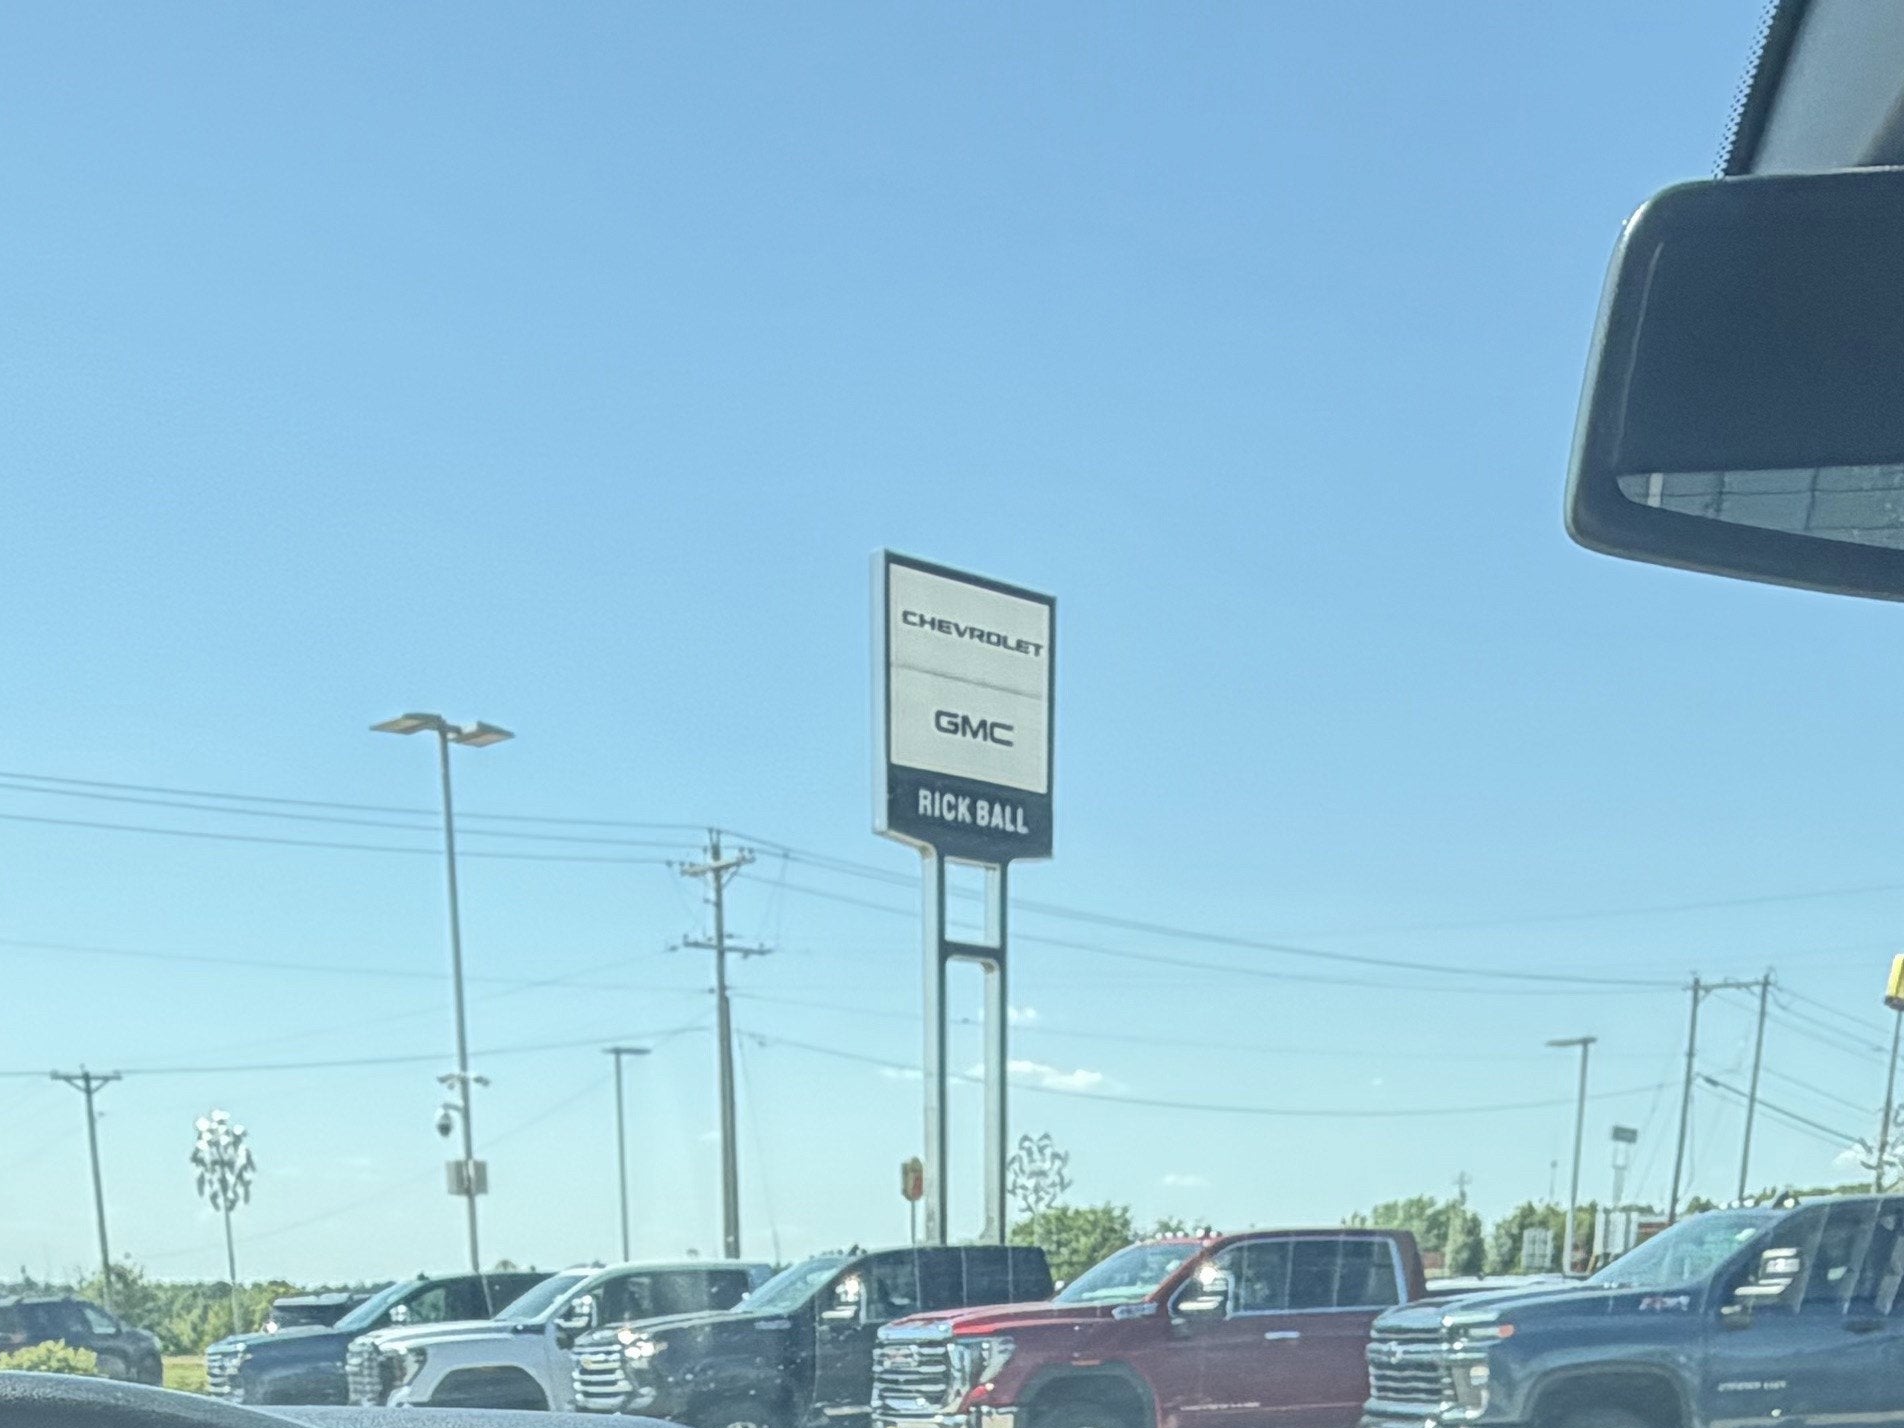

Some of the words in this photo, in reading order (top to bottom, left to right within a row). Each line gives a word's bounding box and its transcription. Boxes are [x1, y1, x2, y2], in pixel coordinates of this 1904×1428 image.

[901, 609, 1044, 658] CHEVROLET
[934, 709, 1014, 747] GMC
[918, 788, 972, 824] RICK
[976, 800, 1029, 835] BALL
